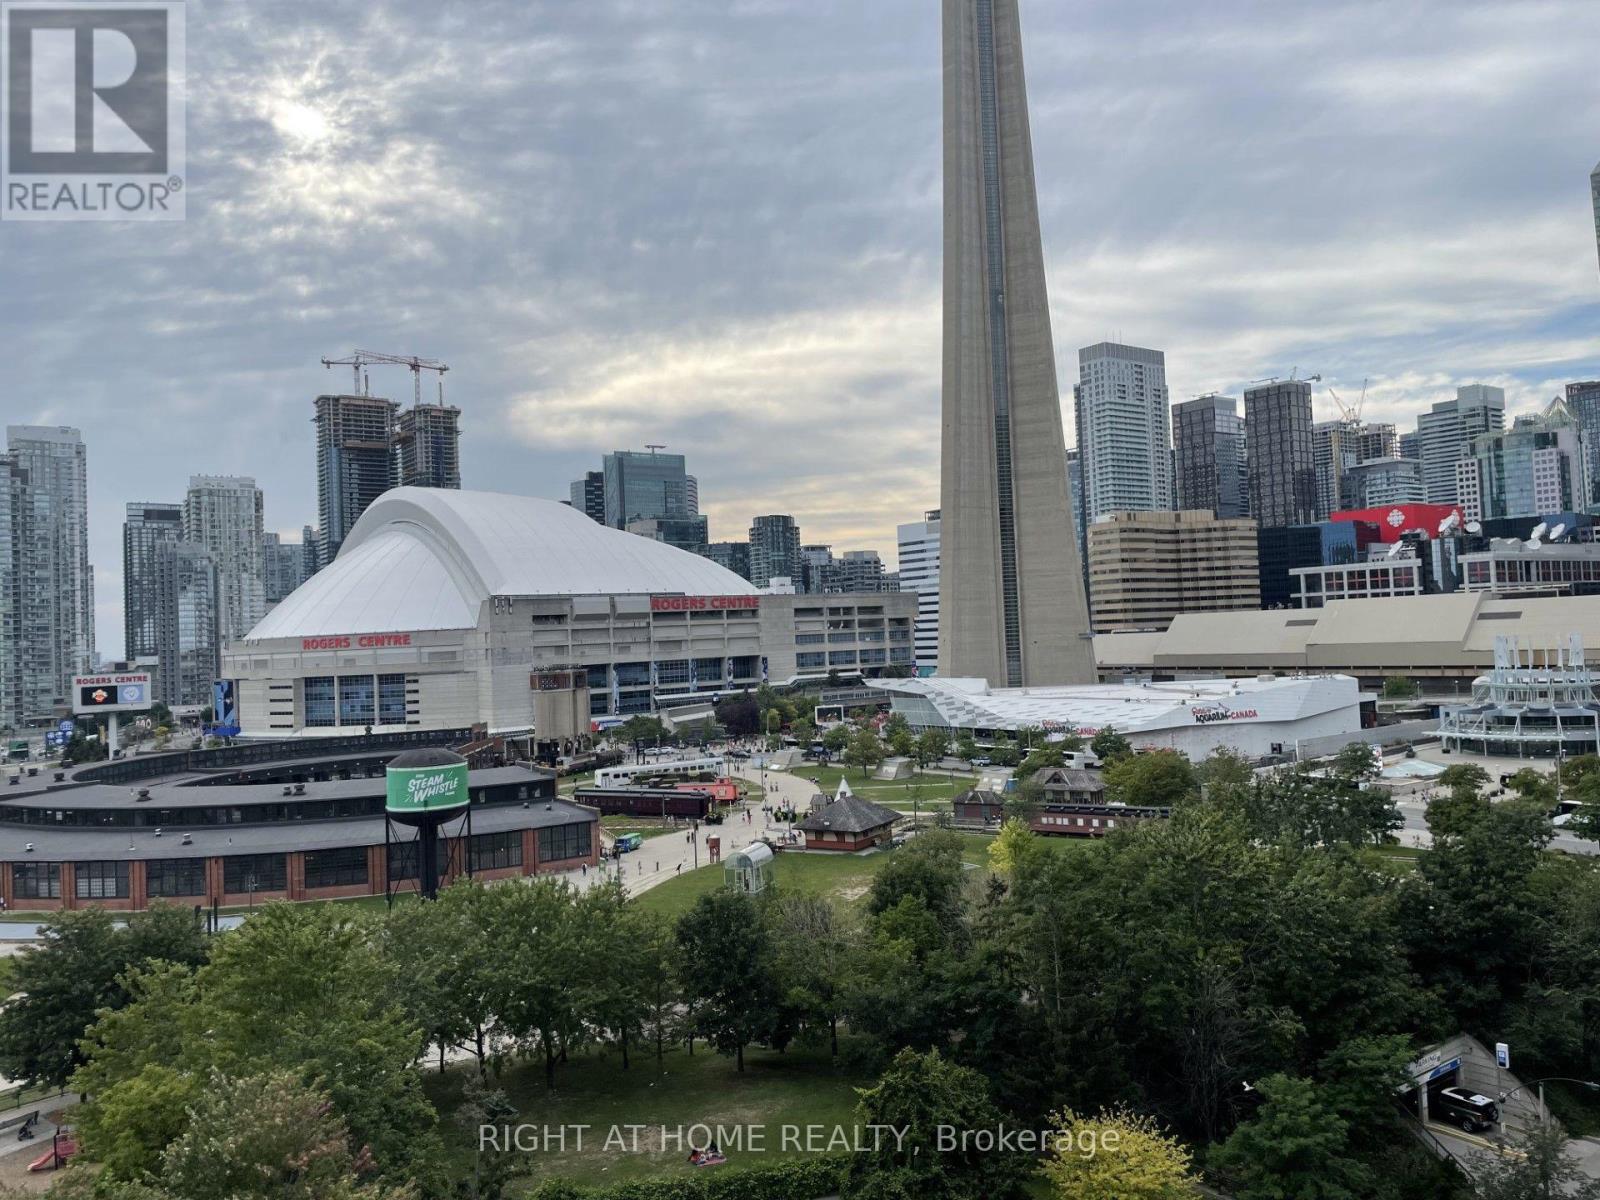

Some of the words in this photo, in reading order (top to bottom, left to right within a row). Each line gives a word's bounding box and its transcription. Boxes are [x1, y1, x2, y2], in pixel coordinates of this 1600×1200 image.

[651, 597, 705, 610] ROGERS
[711, 596, 759, 609] CENTRE
[303, 637, 350, 650] ROGERS
[359, 634, 411, 647] CENTRE
[76, 677, 112, 685] ROGERS
[115, 675, 148, 683] CENTRE
[1231, 709, 1258, 720] CANADA
[408, 774, 444, 792] STEAM
[414, 777, 459, 803] WHISTLE
